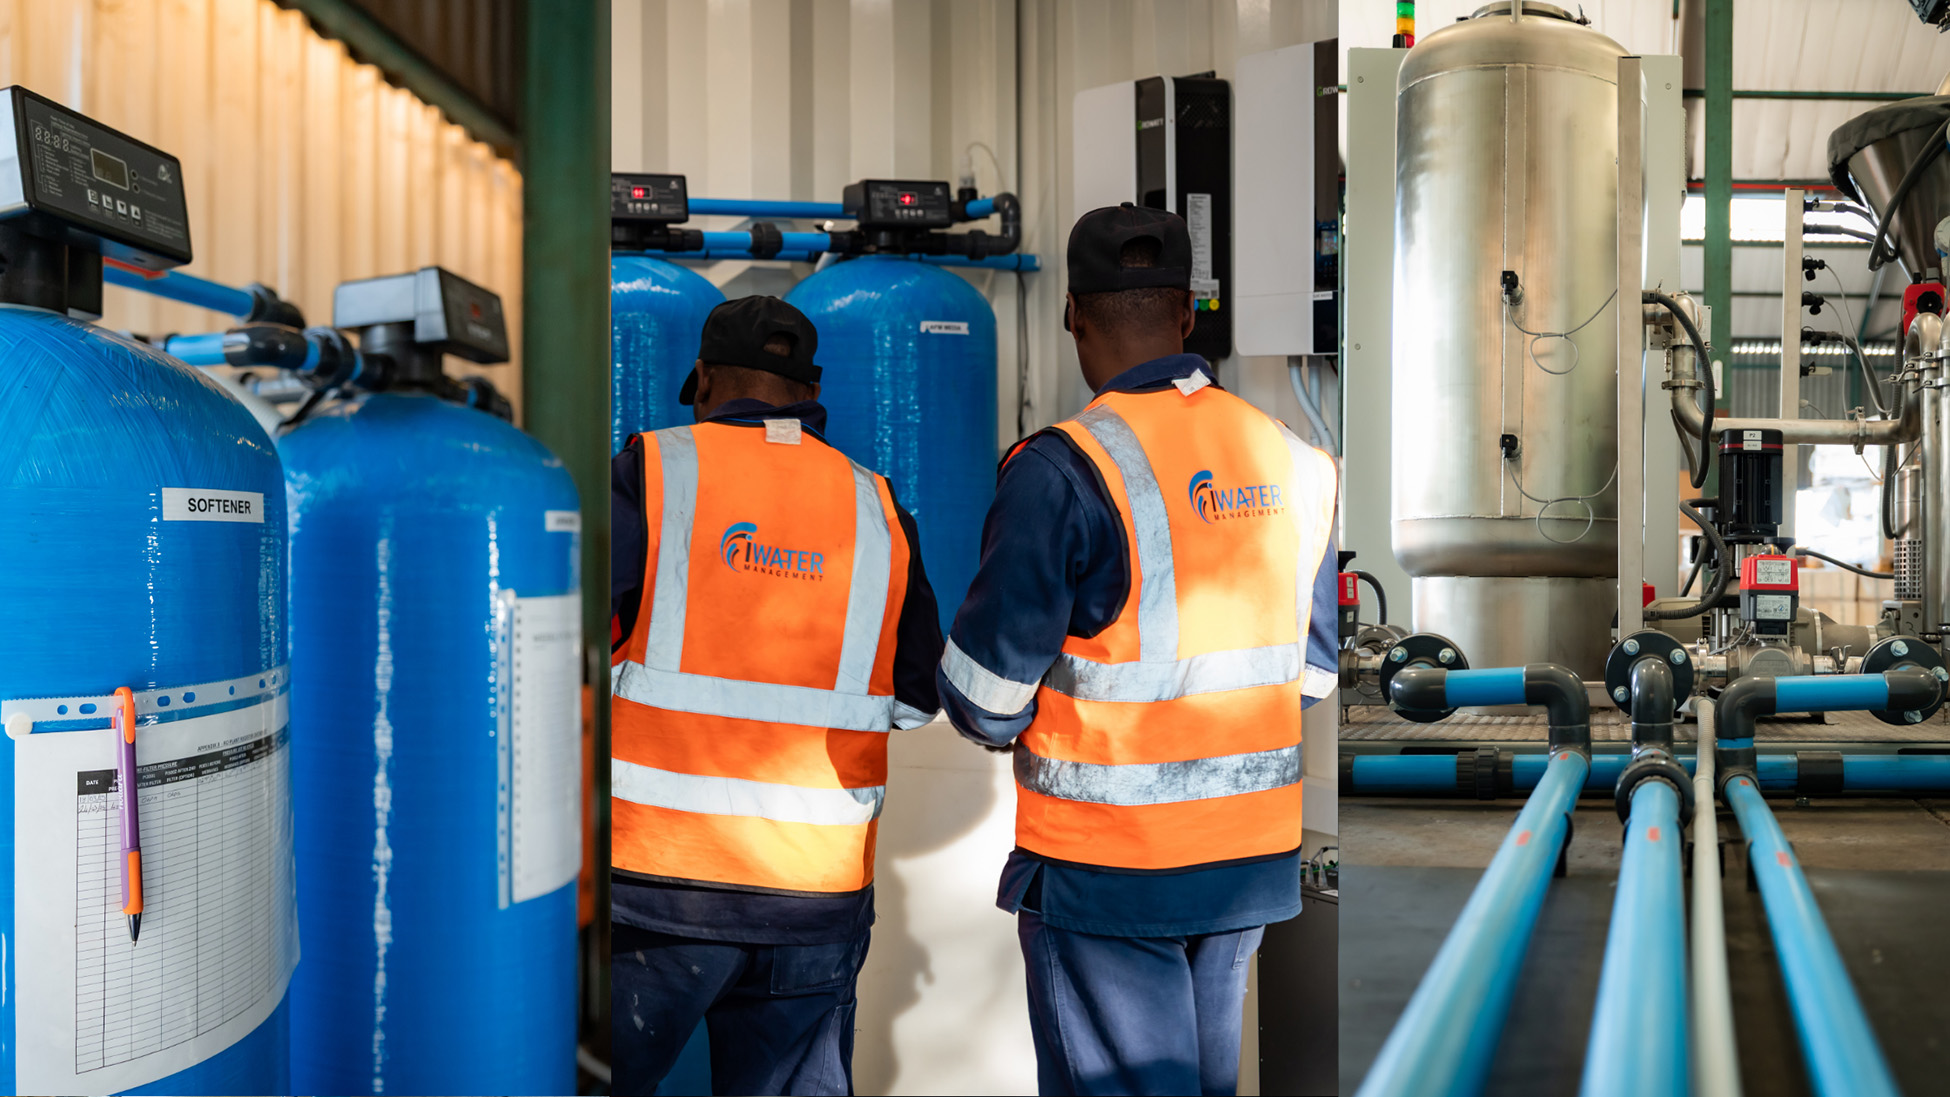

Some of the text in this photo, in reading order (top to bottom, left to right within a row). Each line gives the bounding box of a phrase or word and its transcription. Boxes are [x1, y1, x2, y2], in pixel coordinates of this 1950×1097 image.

[188, 497, 252, 515] SOFTENER
[1214, 508, 1285, 521] MANAGEMENT
[744, 564, 823, 582] MANAGEMENT
